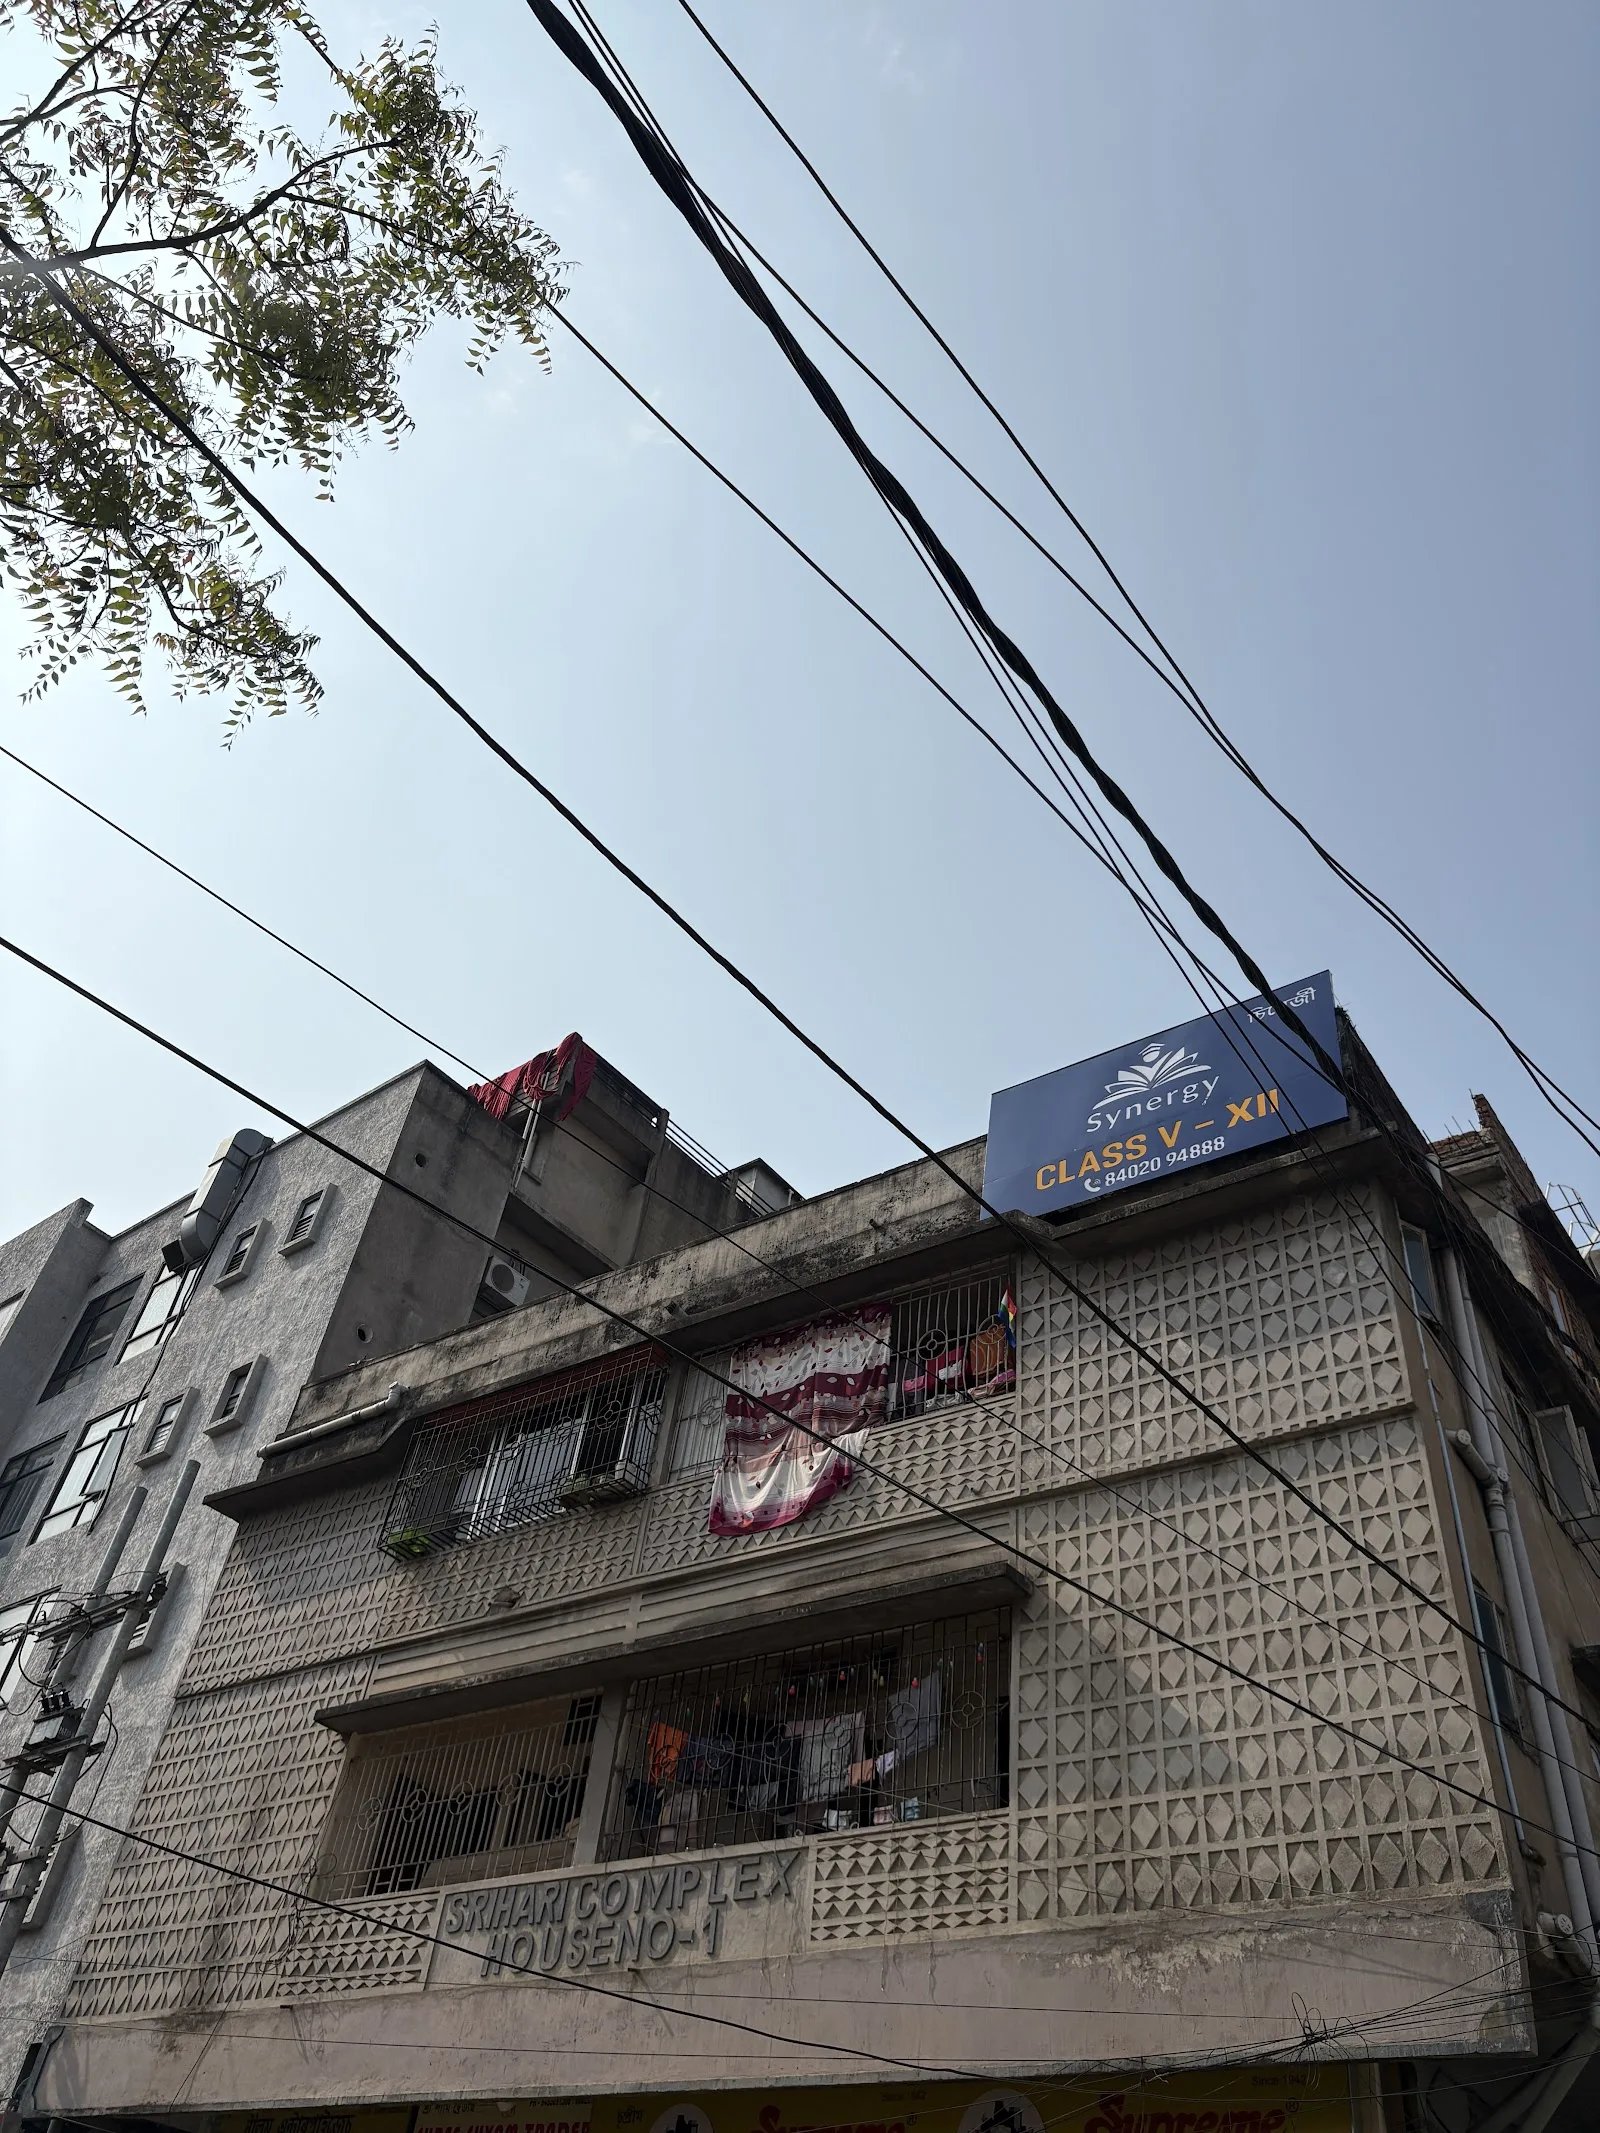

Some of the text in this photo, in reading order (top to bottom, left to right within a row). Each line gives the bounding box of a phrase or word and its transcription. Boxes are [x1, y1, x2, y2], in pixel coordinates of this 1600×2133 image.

[1035, 1133, 1148, 1191] CLASS
[1157, 1120, 1183, 1149] V
[1225, 1088, 1280, 1129] XII
[1086, 1075, 1220, 1133] Synergy
[1104, 1135, 1226, 1188] 84020 94888
[445, 1850, 802, 1934] SRIHARI COMPLEX
